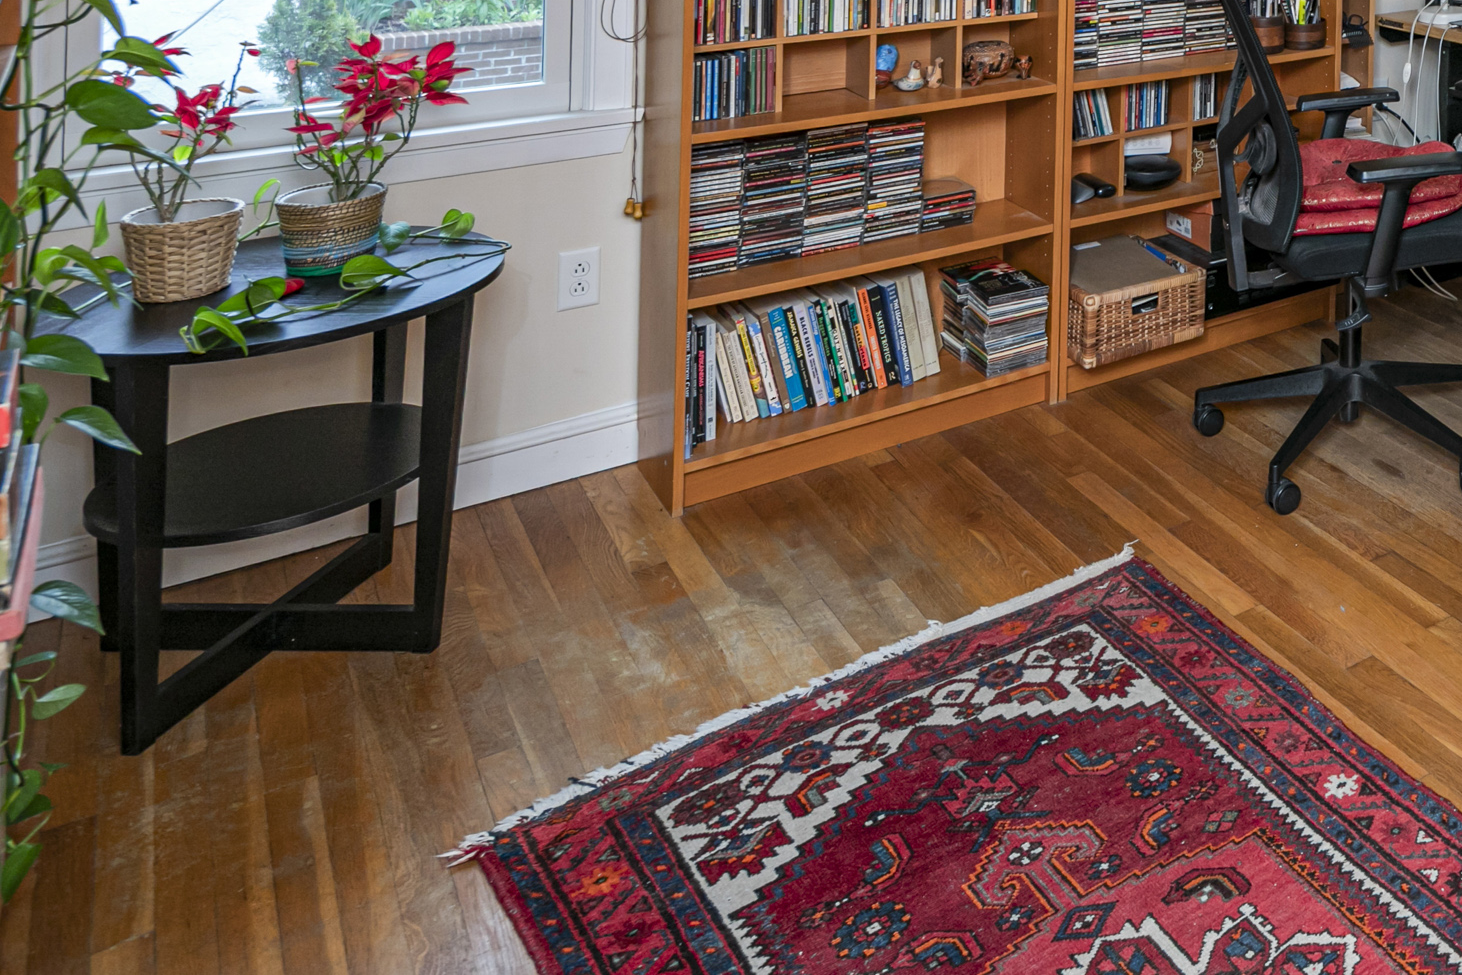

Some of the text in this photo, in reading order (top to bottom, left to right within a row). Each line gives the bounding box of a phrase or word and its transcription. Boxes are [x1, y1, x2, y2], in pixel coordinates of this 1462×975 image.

[787, 311, 797, 335] JAMAICA
[793, 336, 803, 357] GENESIS
[799, 316, 813, 357] BLACK REBELS
[818, 316, 826, 336] Reggae
[823, 337, 831, 356] Routes
[875, 310, 891, 362] NAKED TROPICS
[898, 327, 903, 335] OF
[774, 326, 794, 379] CARIBBEAN
[899, 335, 909, 371] MESOAMERICA
